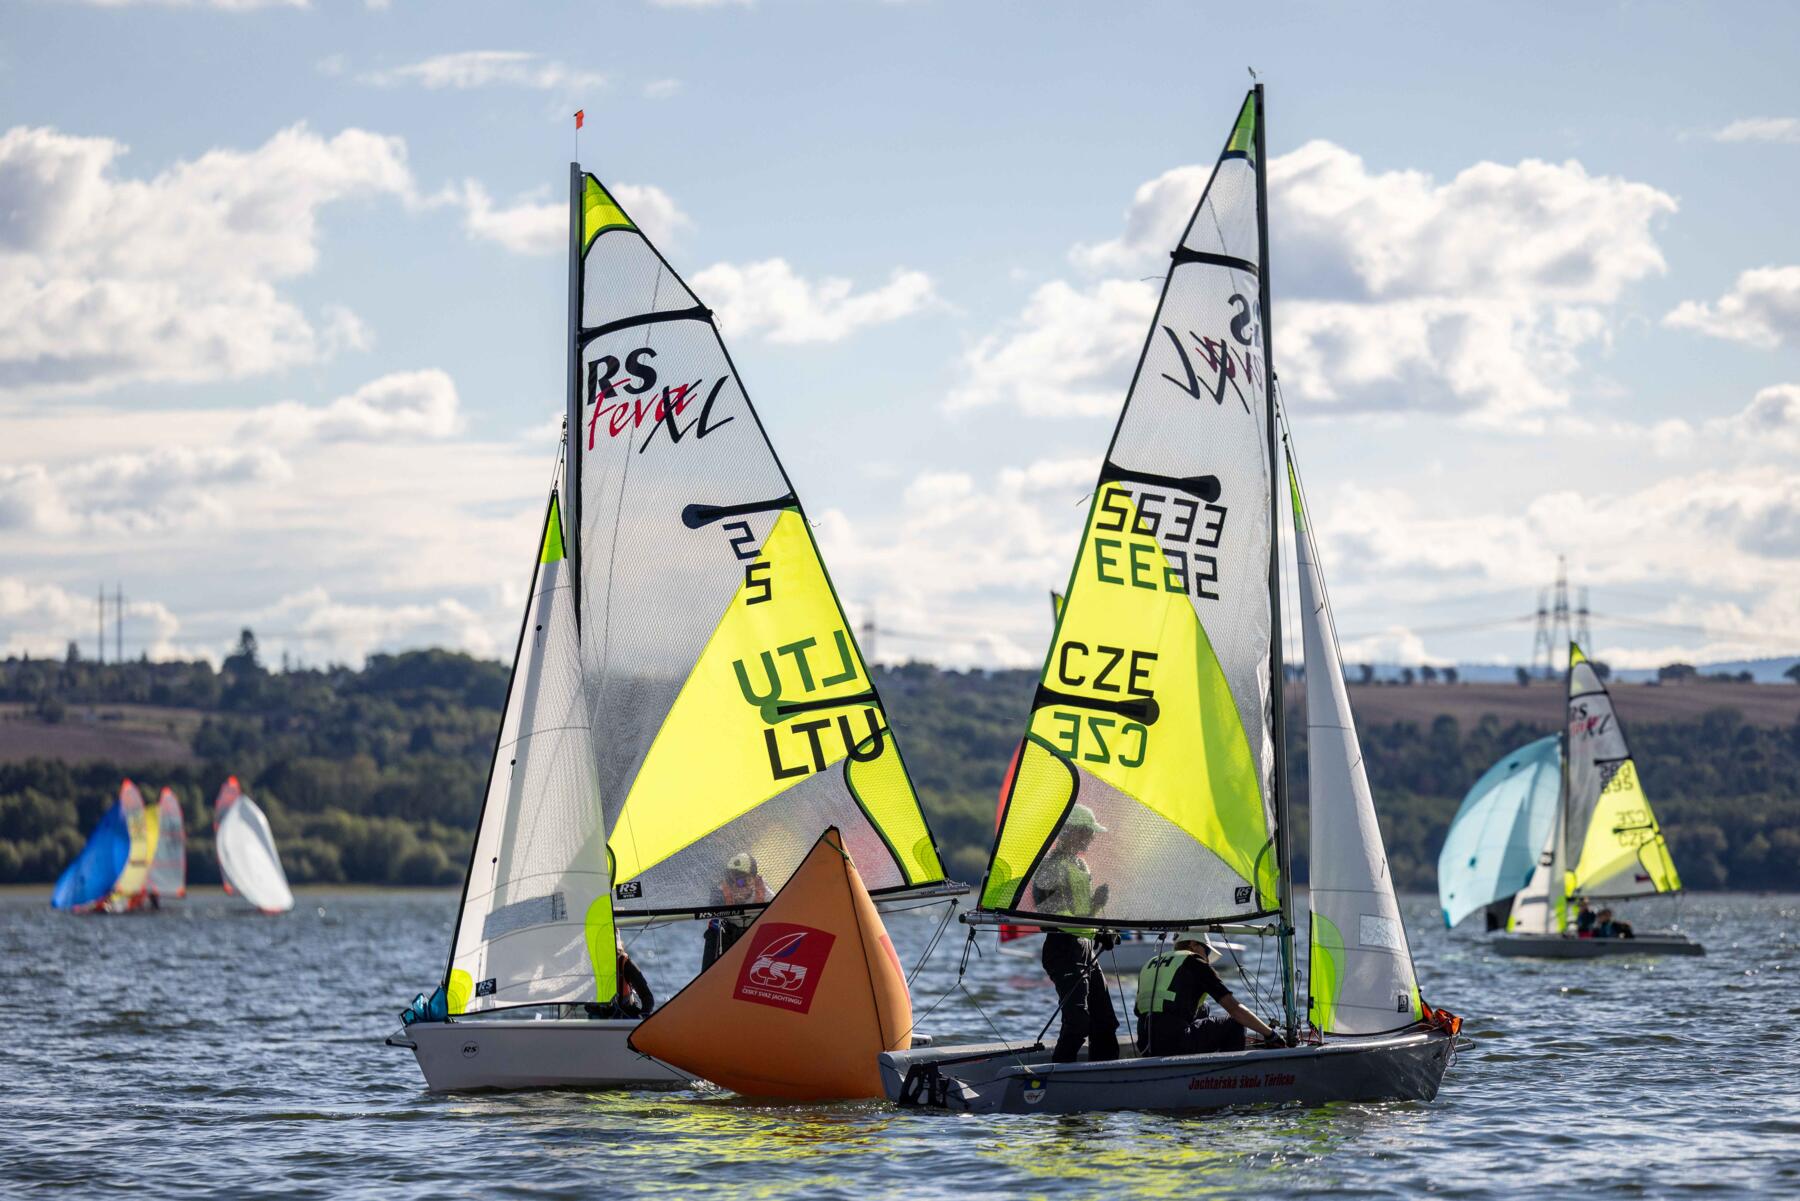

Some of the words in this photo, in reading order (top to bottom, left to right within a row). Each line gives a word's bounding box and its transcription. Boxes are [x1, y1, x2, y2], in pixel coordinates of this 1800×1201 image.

[587, 347, 657, 405] RS
[638, 375, 734, 454] XL
[1096, 487, 1228, 549] 5633
[745, 561, 772, 606] 5
[1058, 640, 1158, 698] CZE
[763, 708, 885, 781] LTU
[619, 882, 638, 893] RS
[478, 979, 494, 992] RS
